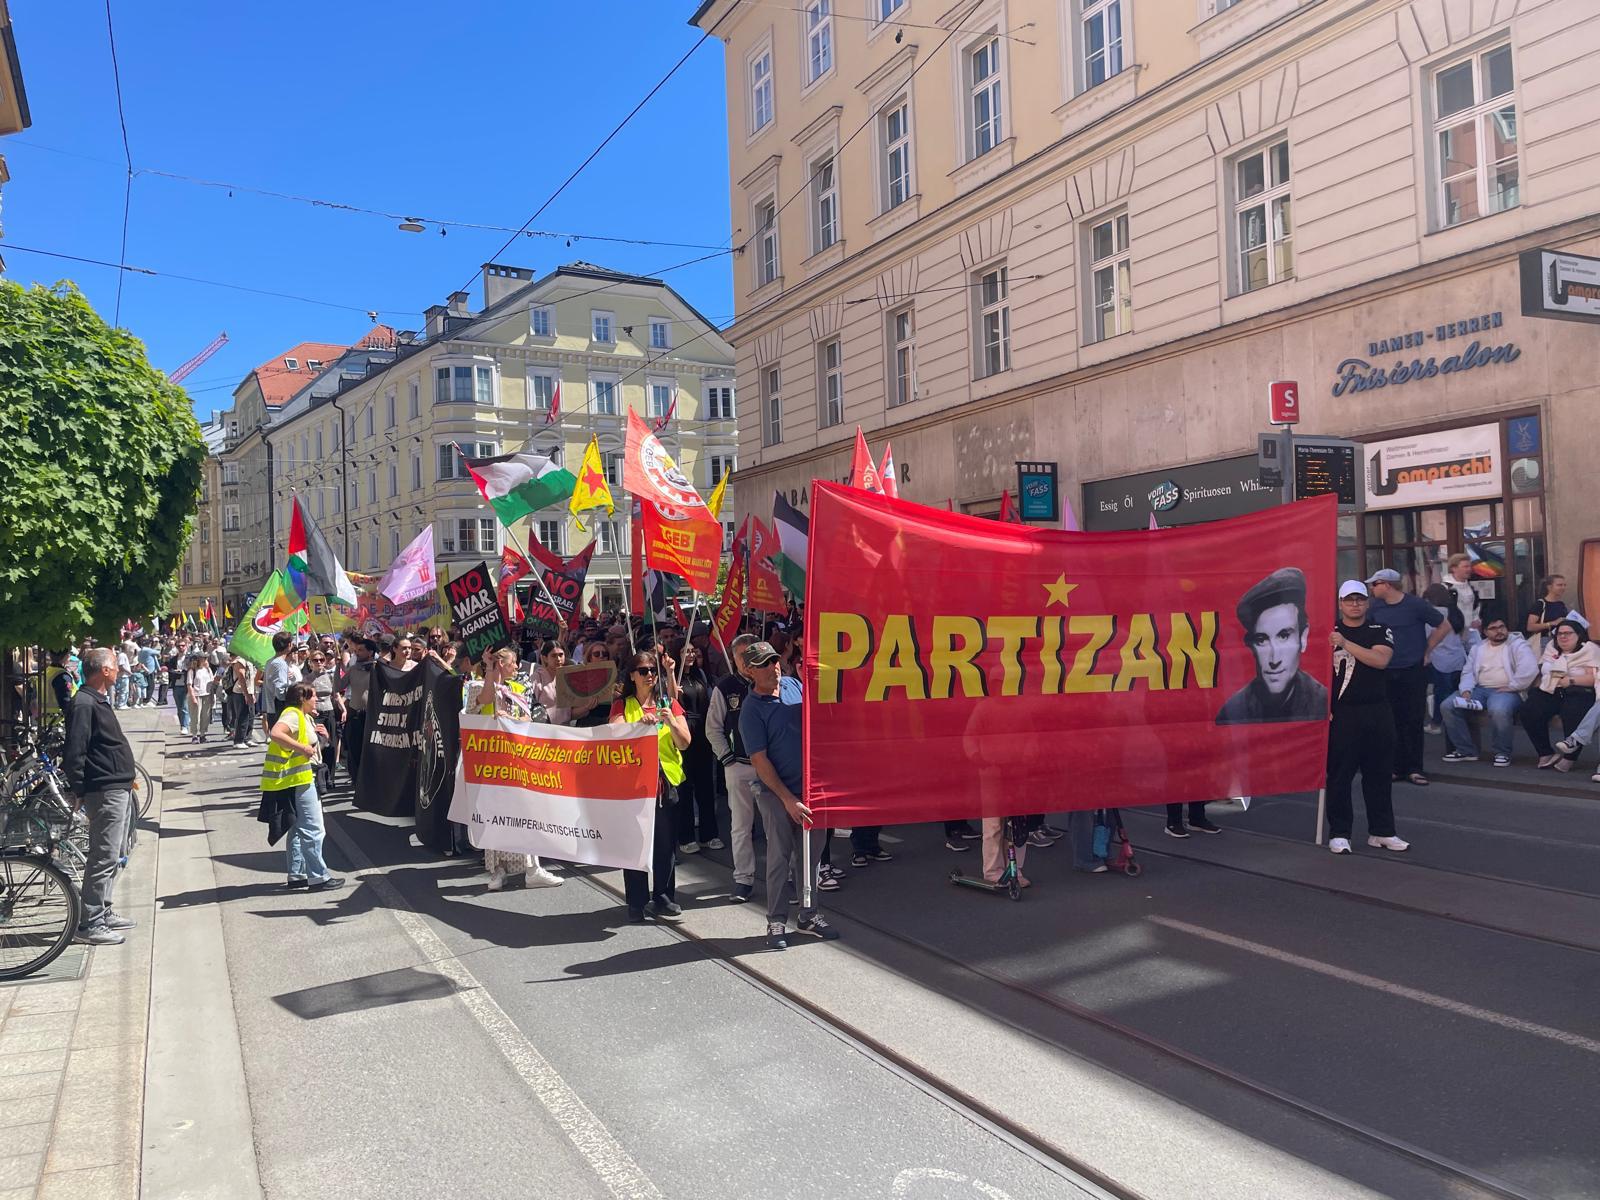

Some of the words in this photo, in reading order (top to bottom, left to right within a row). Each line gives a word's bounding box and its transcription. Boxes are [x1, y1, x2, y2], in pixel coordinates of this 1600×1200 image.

[1332, 341, 1521, 397] Frisiersalon
[1284, 389, 1295, 407] S
[1030, 484, 1049, 497] FASS
[1147, 485, 1164, 501] vom
[1153, 488, 1179, 511] FASS
[1183, 486, 1232, 503] Spirituosen
[1100, 501, 1118, 513] Essig
[450, 570, 483, 603] NO
[545, 572, 579, 600] NO
[453, 588, 493, 620] WAR
[461, 608, 499, 638] AGAINST
[466, 626, 506, 656] IRAN!
[817, 611, 1220, 704] PARTIZAN
[466, 734, 571, 763] Antiimperialisten
[574, 746, 592, 764] der
[597, 745, 642, 766] Welt,
[474, 763, 530, 786] vereinigt
[531, 771, 564, 789] euch!
[471, 813, 484, 824] AIL
[492, 816, 580, 837] ANTIIMPERIALISTISCHE
[581, 829, 602, 840] LIGA
